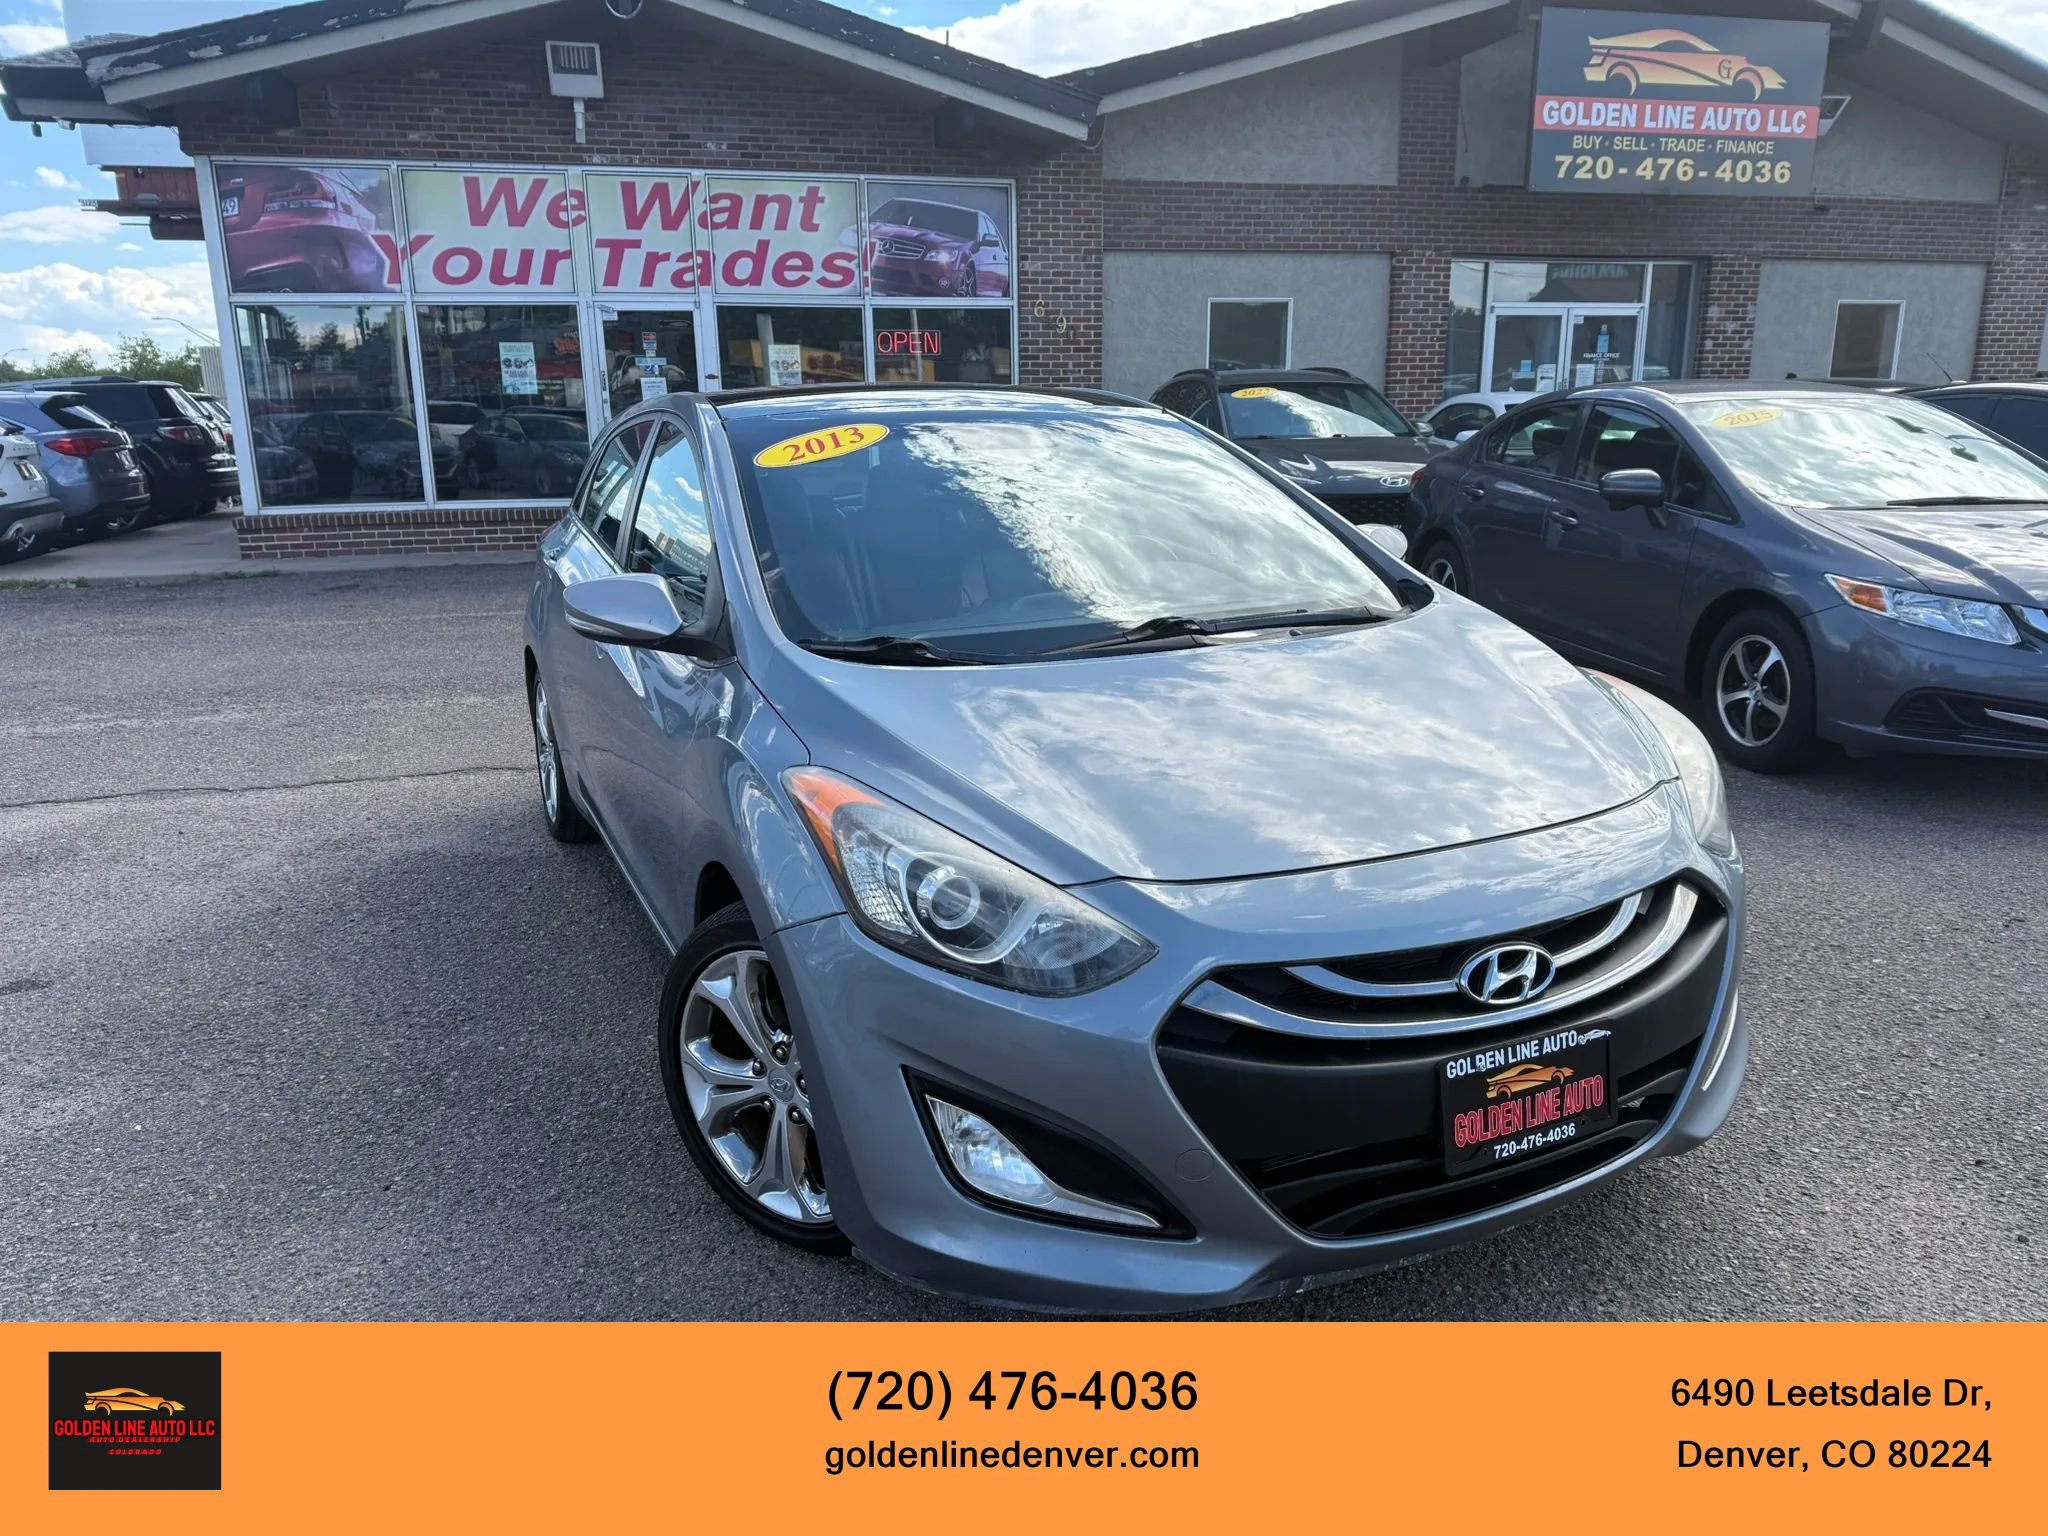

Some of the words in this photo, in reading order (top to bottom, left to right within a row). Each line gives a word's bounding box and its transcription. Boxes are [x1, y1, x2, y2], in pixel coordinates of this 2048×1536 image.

[1542, 100, 1638, 127] GOLDEN
[1644, 103, 1696, 130] LINE
[1701, 106, 1761, 133] AUTO
[1767, 108, 1807, 134] LLC
[1572, 135, 1603, 149] BUY
[1613, 136, 1649, 151] SELL
[1659, 137, 1706, 152] TRADE
[1716, 139, 1775, 154] FINANCE
[462, 175, 587, 230] We
[620, 180, 825, 233] Want
[371, 234, 573, 287] Your
[595, 238, 877, 290] Trades!
[877, 331, 940, 354] OPEN
[1724, 410, 1774, 426] 2015
[783, 426, 865, 462] 2013
[1446, 1049, 1504, 1079] GOLDEN
[1508, 1039, 1540, 1064] LINE
[1542, 1030, 1578, 1055] AUTO
[1454, 1098, 1523, 1148] GOLDEN
[1525, 1087, 1561, 1128] LINE
[1563, 1075, 1604, 1117] AUTO
[1494, 1122, 1576, 1159] 720-476-4036
